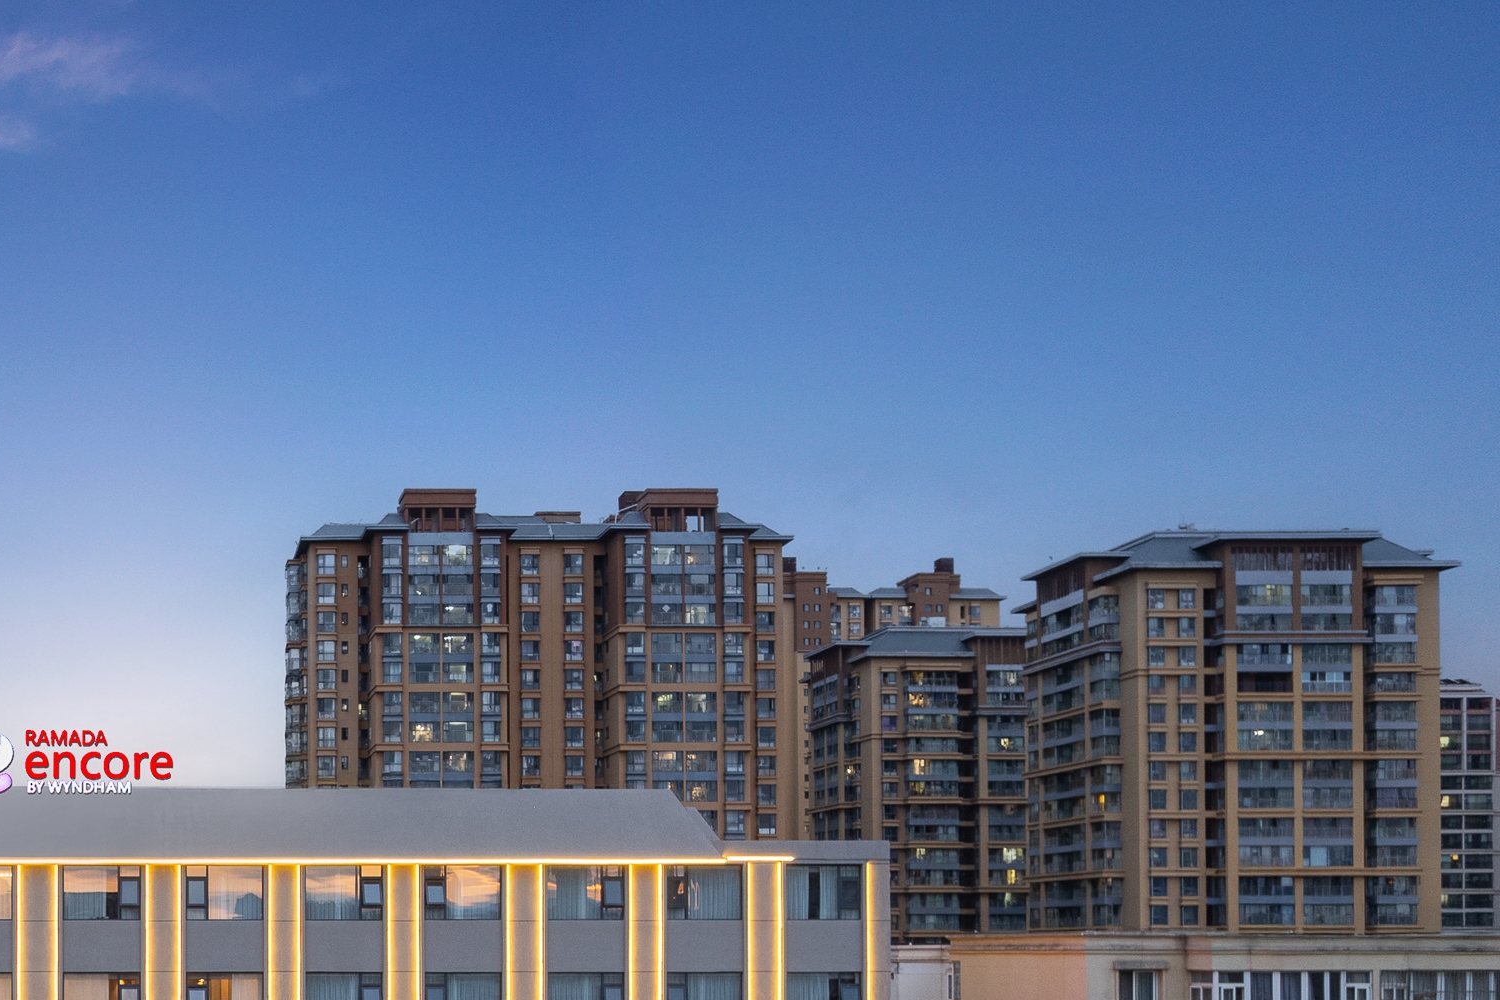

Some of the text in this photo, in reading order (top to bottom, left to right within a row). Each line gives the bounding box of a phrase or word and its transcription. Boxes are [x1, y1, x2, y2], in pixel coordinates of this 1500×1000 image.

[25, 729, 108, 747] RAMADA
[24, 750, 174, 780] encore
[26, 780, 132, 794] BY WYNDHAM
